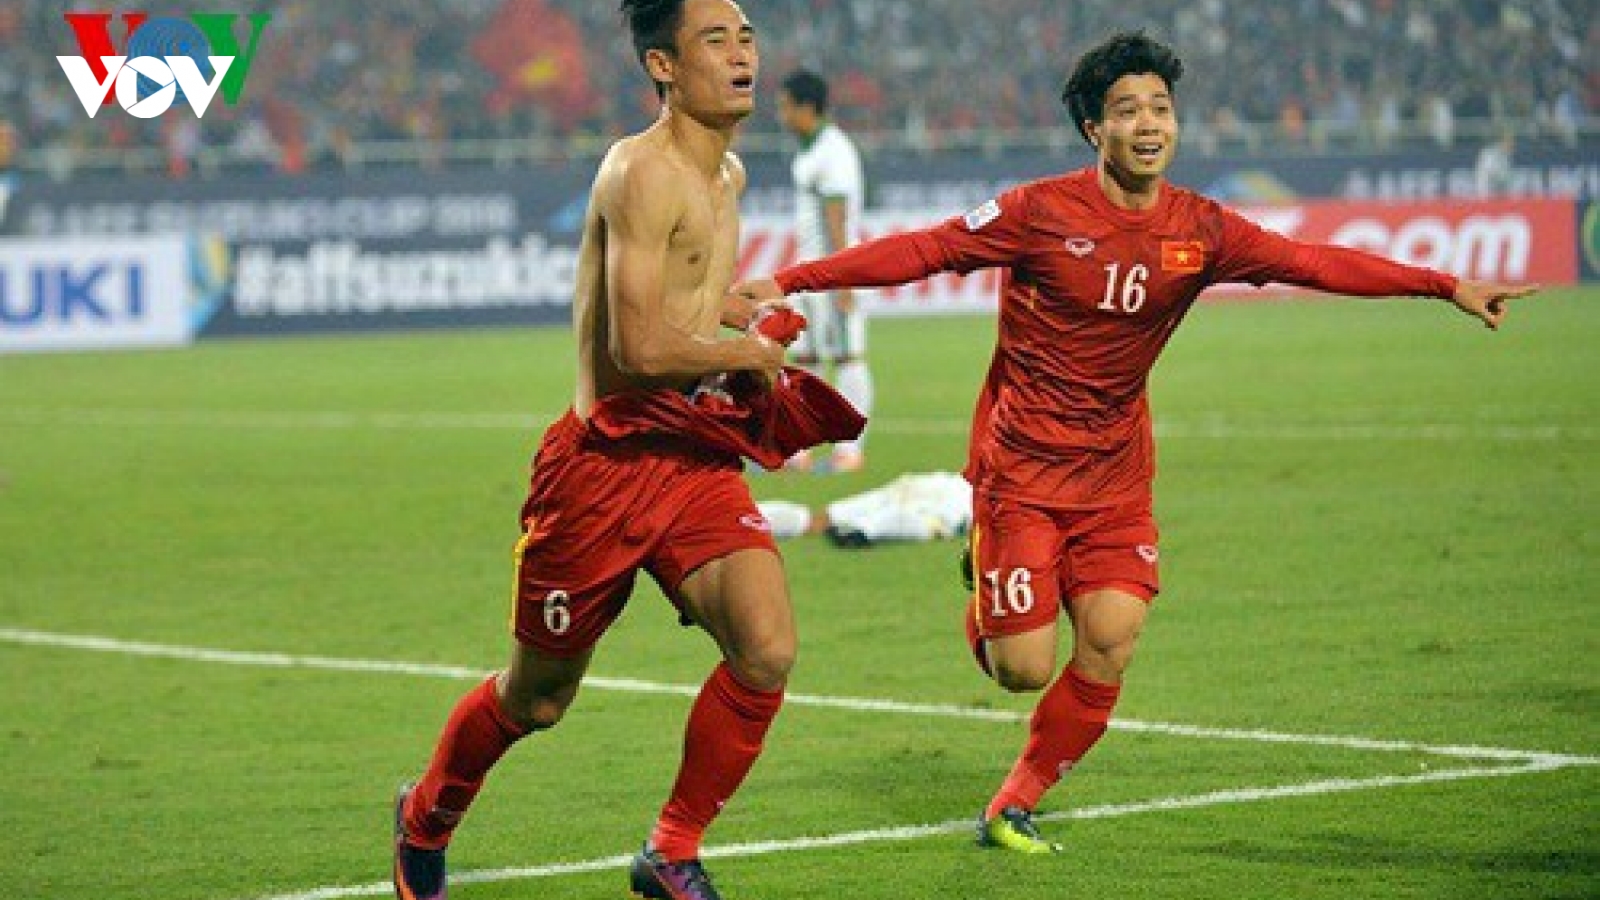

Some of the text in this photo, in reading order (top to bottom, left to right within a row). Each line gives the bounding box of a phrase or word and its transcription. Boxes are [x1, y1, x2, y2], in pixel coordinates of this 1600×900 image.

[0, 263, 144, 325] UKI
[1097, 262, 1148, 313] 16
[543, 589, 571, 634] 6
[985, 567, 1034, 617] 16
